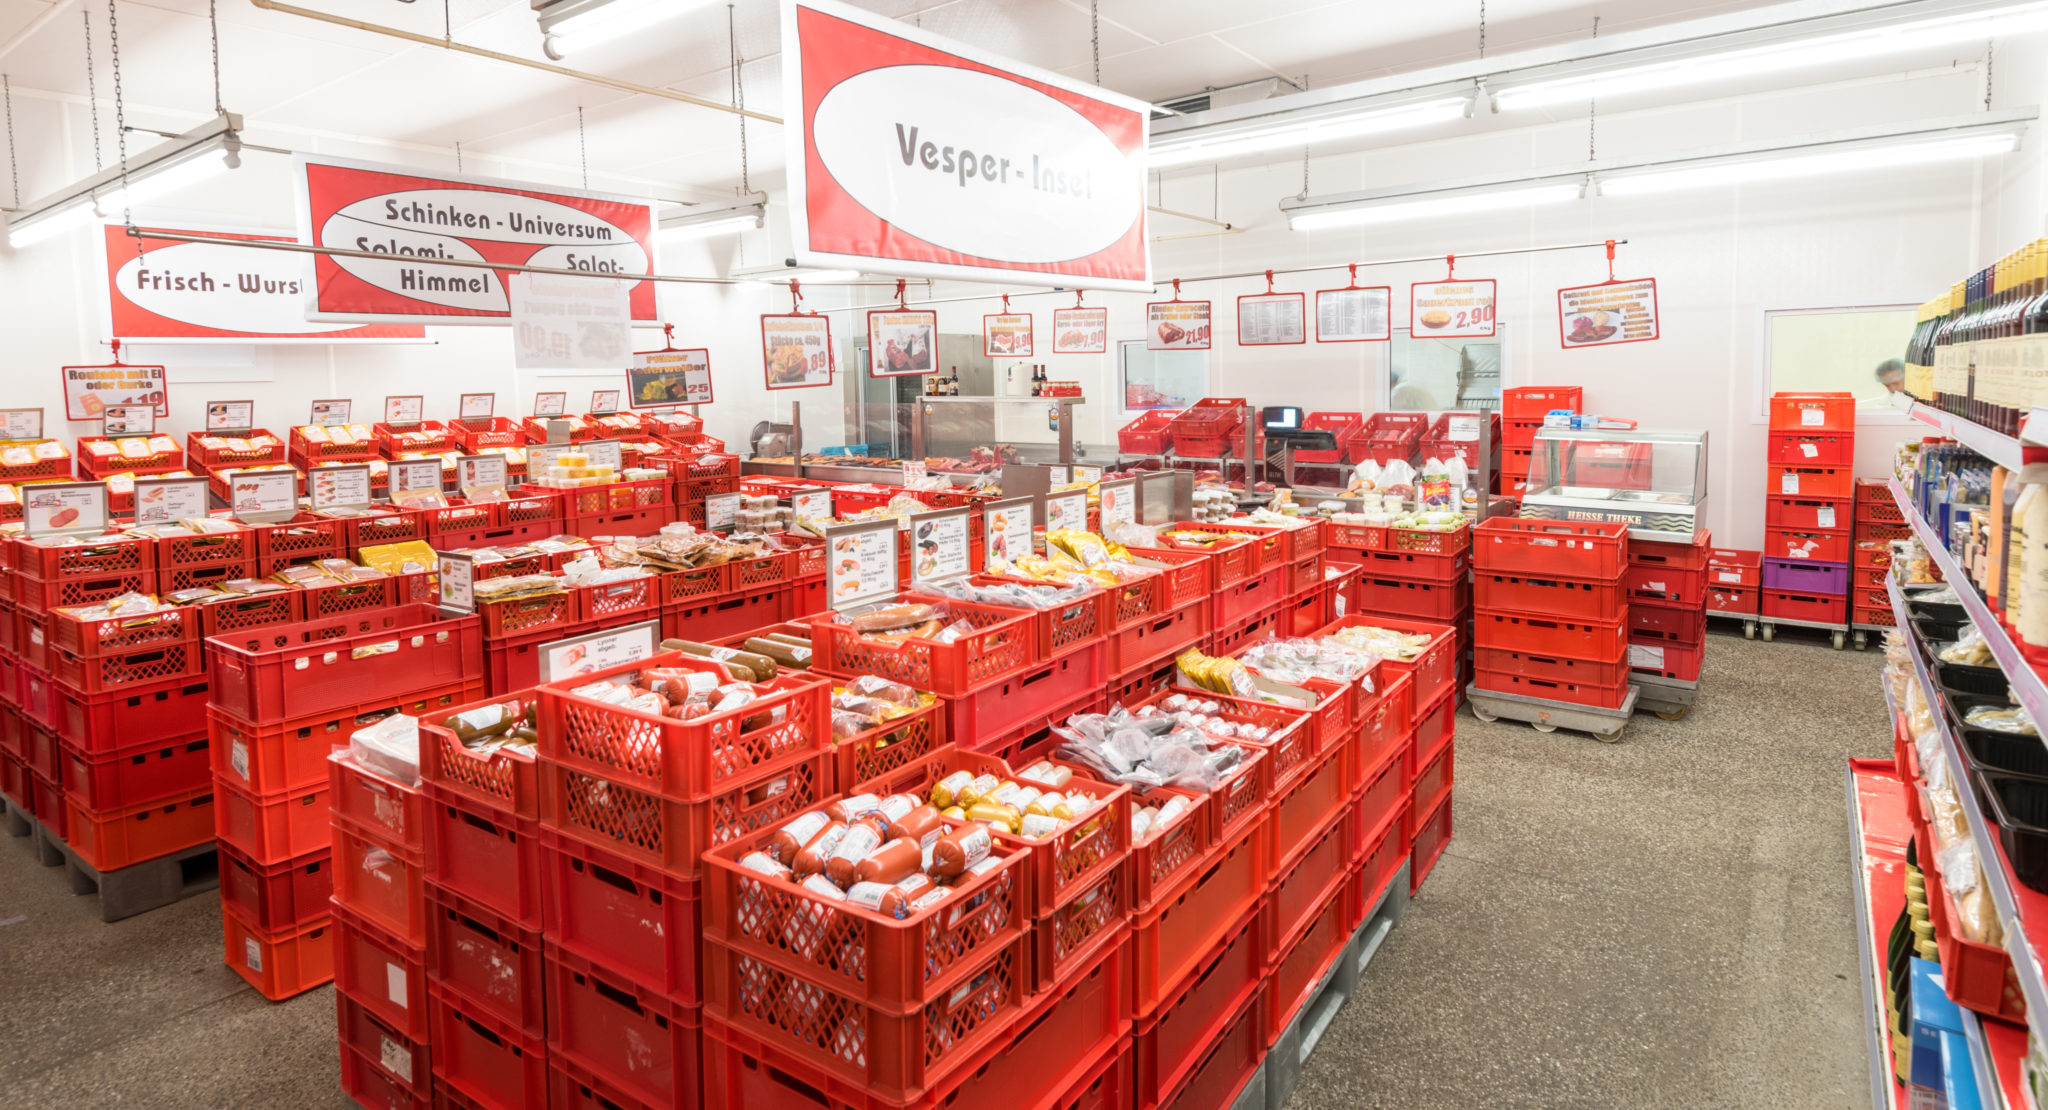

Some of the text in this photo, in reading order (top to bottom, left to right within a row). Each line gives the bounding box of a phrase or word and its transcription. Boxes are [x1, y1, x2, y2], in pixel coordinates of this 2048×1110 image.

[895, 122, 1010, 188] Vesper
[1032, 154, 1093, 200] Insel
[385, 199, 490, 230] Schinken
[509, 212, 612, 241] Universum
[137, 269, 215, 292] Frisch
[238, 273, 303, 295] Wurs
[400, 269, 490, 294] Himmel
[1456, 304, 1493, 329] 2,90
[1186, 324, 1209, 344] 21,90
[68, 369, 124, 380] Roulade
[126, 369, 149, 380] mit
[86, 380, 153, 390] oder Gurke
[1567, 510, 1642, 525] HEISSE THEKE
